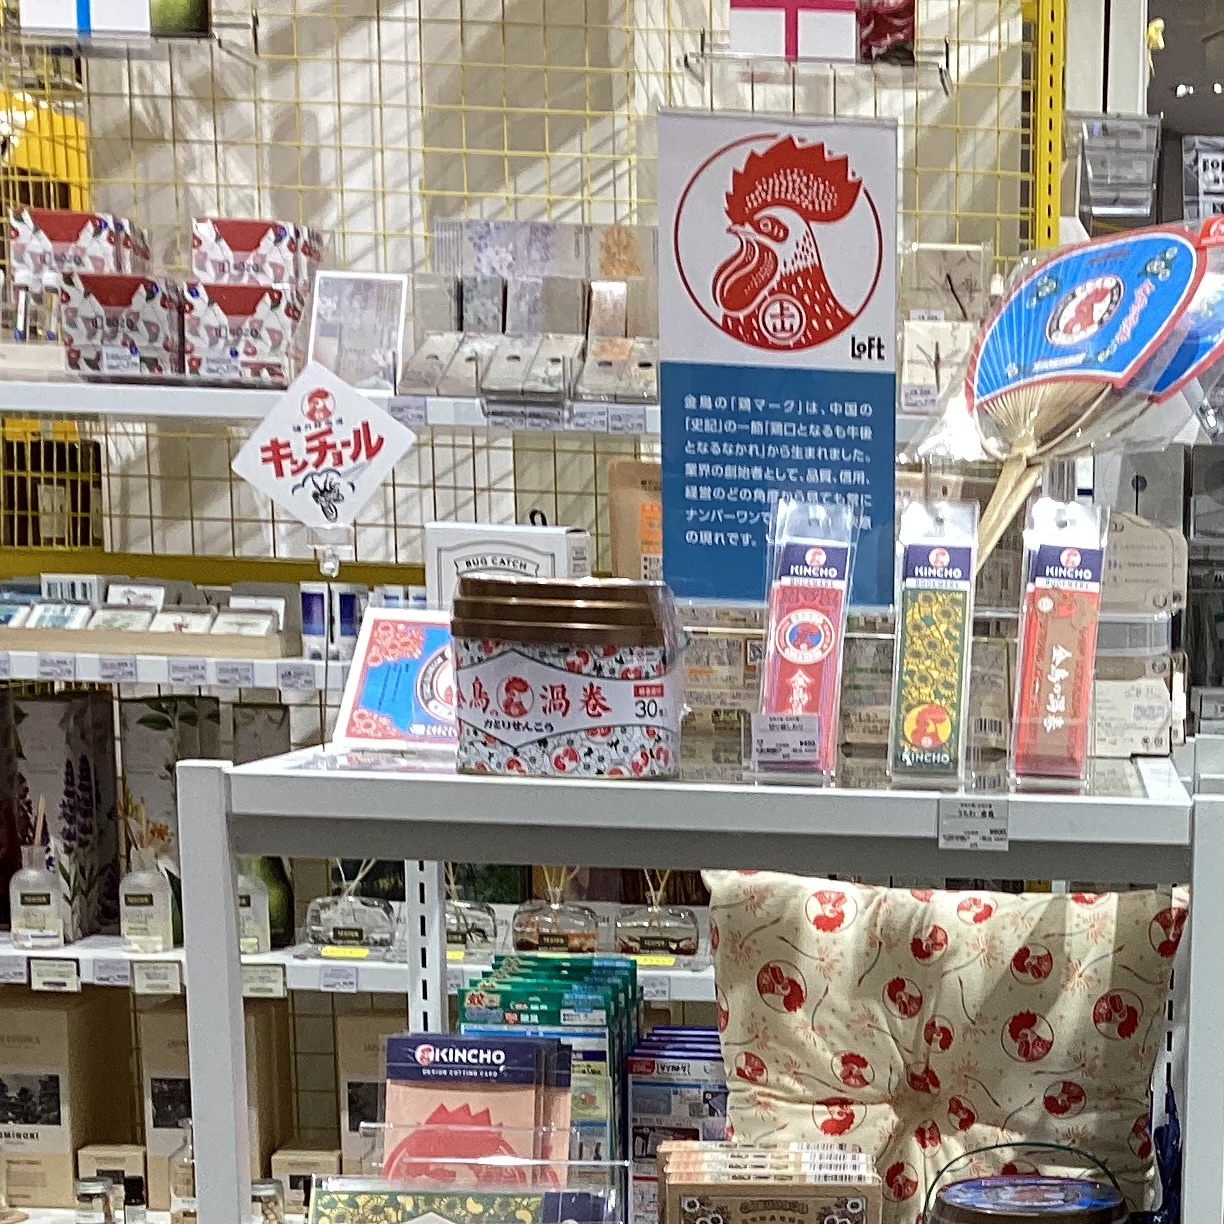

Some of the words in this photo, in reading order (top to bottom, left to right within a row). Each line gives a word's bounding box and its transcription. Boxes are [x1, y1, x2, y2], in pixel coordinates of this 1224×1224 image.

[260, 419, 384, 479] キンチョール
[491, 557, 528, 570] CATCH
[790, 564, 838, 578] KINCHO
[914, 565, 962, 579] KINCHO
[1045, 565, 1093, 579] KINCHO
[435, 1047, 506, 1065] KINCHO
